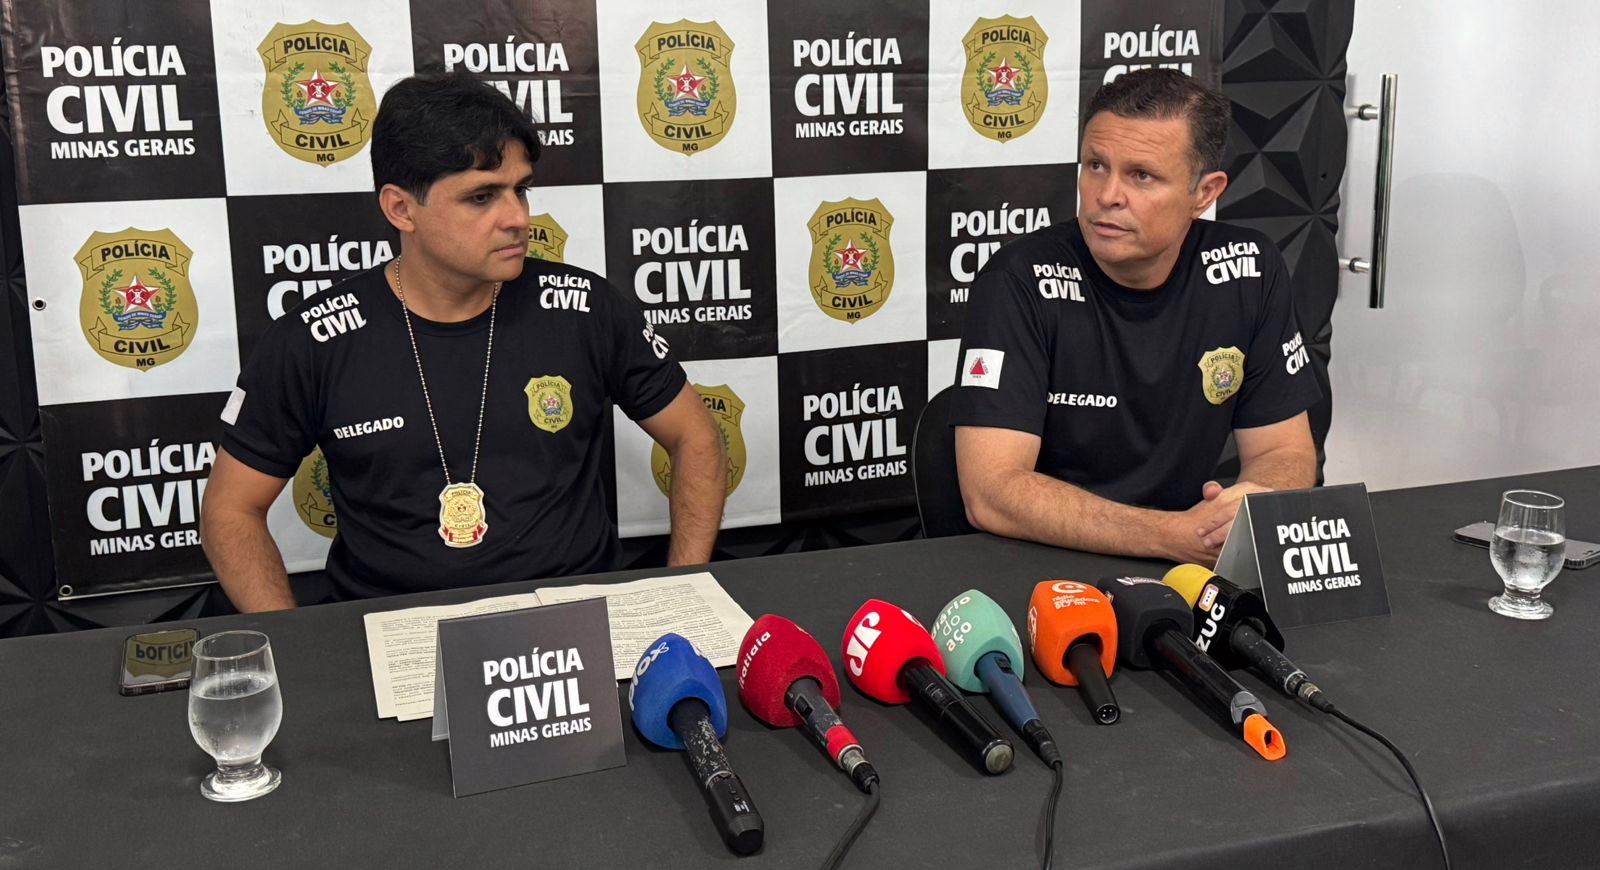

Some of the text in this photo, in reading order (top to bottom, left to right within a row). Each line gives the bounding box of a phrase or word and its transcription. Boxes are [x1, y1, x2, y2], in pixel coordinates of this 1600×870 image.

[283, 33, 351, 55] POLÍCIA
[657, 31, 716, 51] POLÍCIA
[982, 24, 1031, 45] POLÍCIA
[1104, 24, 1200, 59] POLÍCIA
[41, 38, 187, 78] POLÍCIA
[443, 35, 570, 73] POLÍCIA
[793, 31, 902, 68] POLÍCIA
[793, 72, 904, 116] CIVIL
[46, 84, 193, 135] CIVIL
[983, 113, 1025, 127] CIVIL
[664, 124, 712, 139] CIVIL
[795, 119, 904, 138] MINAS GERAIS
[997, 130, 1012, 139] MG
[51, 137, 196, 160] MINAS GERAIS
[295, 133, 350, 149] CIVIL
[682, 143, 699, 152] MG
[316, 153, 335, 163] MG
[826, 207, 877, 228] POLÍCIA
[951, 203, 1051, 238] POLÍCIA
[632, 220, 749, 256] POLÍCIA
[101, 240, 171, 261] POLÍCIA
[263, 234, 394, 274] POLÍCIA
[1201, 241, 1260, 265] POLÍCIA
[539, 274, 591, 291] POLÍCIA
[634, 258, 751, 304] CIVIL
[1033, 263, 1083, 281] POLÍCIA
[1206, 257, 1261, 285] CIVIL
[539, 287, 591, 313] CIVIL
[831, 294, 873, 308] CIVIL
[1039, 278, 1086, 302] CIVIL
[301, 292, 360, 324] POLÍCIA
[694, 305, 752, 323] GERAIS
[846, 311, 861, 320] MG
[310, 307, 367, 343] CIVIL
[113, 337, 171, 354] CIVIL
[136, 357, 156, 367] MG
[1211, 353, 1235, 363] POLÍCIA
[536, 380, 561, 390] POLÍCIA
[803, 383, 904, 421] POLÍCIA
[1046, 392, 1117, 408] DELEGADO
[333, 416, 405, 439] DELEGADO
[804, 418, 907, 466] CIVIL
[81, 438, 217, 482] POLÍCIA
[804, 460, 907, 487] MINAS GERAIS
[1276, 516, 1351, 545] POLÍCIA
[90, 530, 202, 556] MINAS GER
[1282, 542, 1358, 579] CIVIL
[1287, 574, 1362, 595] MINAS GERAIS
[943, 615, 960, 636] do
[946, 621, 972, 652] aço
[1195, 603, 1226, 652] ZUG
[846, 611, 882, 677] JP
[483, 647, 584, 686] POLÍCIA
[487, 678, 590, 727] CIVIL
[490, 717, 592, 748] MINAS GERAIS
